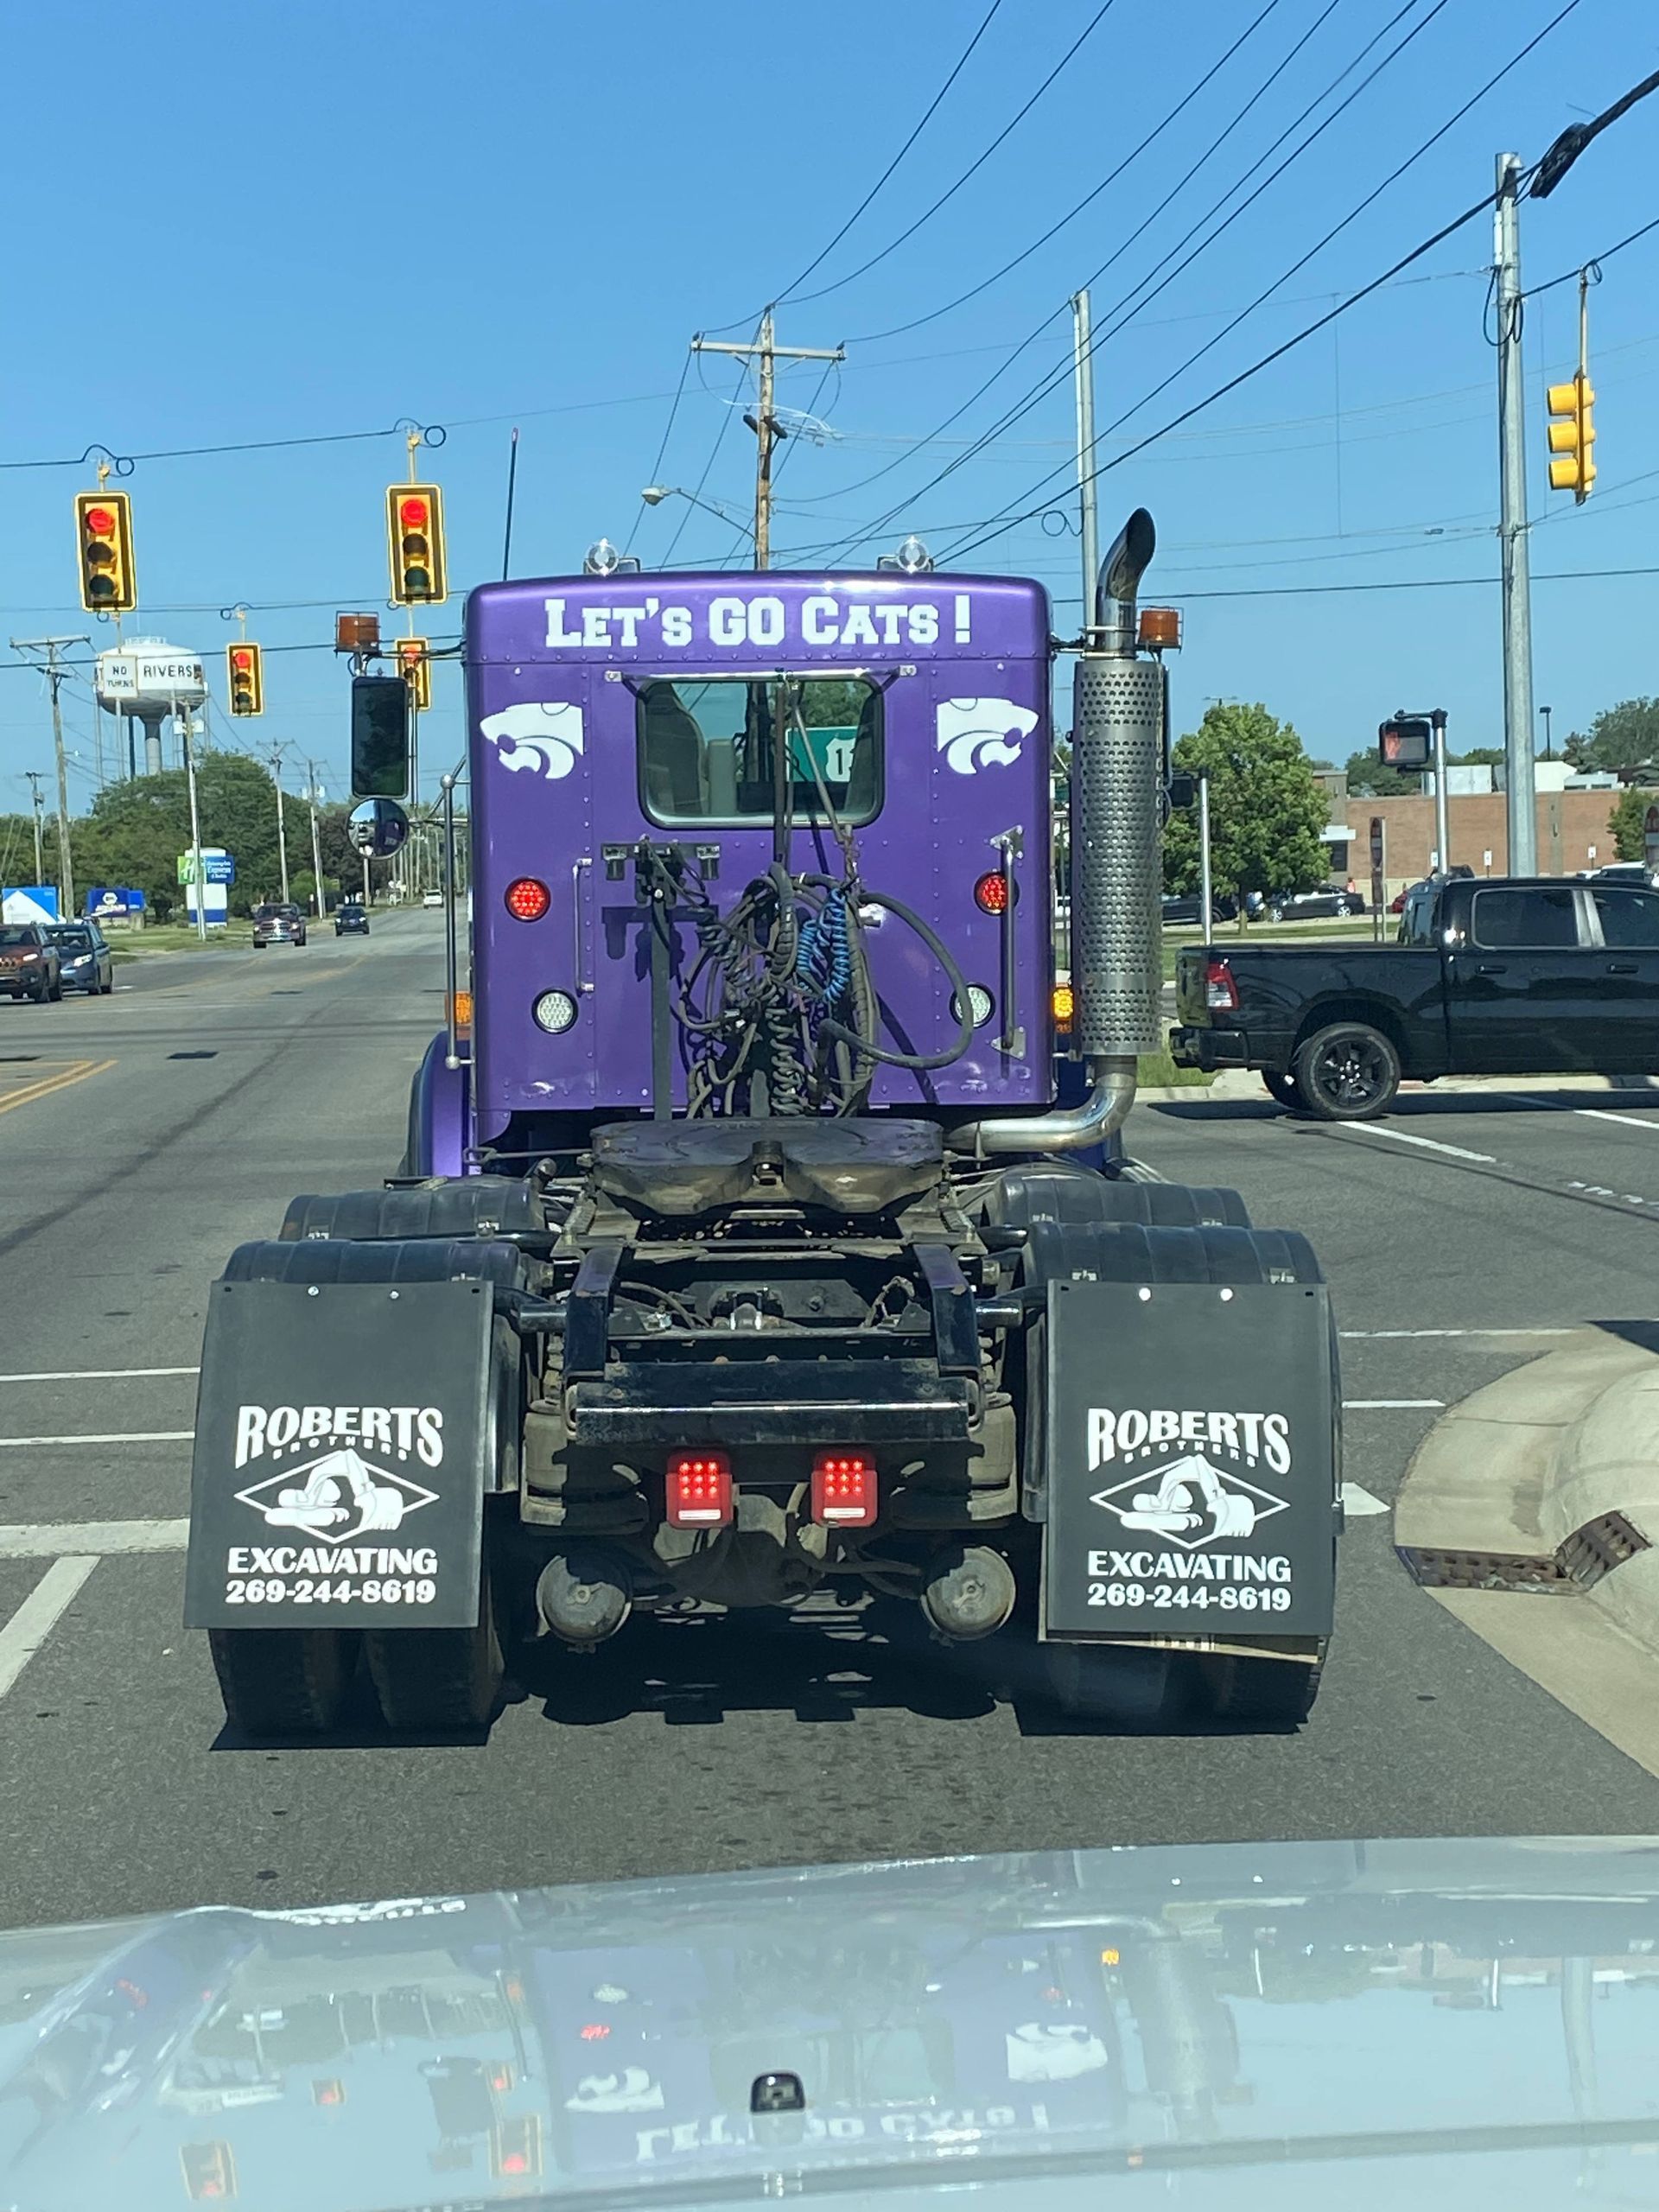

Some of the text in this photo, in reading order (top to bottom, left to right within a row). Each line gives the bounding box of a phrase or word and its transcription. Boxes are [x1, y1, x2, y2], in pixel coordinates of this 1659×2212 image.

[709, 597, 785, 646] GO
[112, 666, 127, 676] NO
[143, 664, 193, 677] RIVERS
[235, 1405, 443, 1469] ROBERTS
[1088, 1408, 1291, 1474] ROBERTS
[227, 1547, 438, 1574] EXCAVATING
[1088, 1550, 1292, 1582] EXCAVATING
[225, 1579, 436, 1604] 269-244-8619
[1087, 1582, 1292, 1611] 269-244-8619
